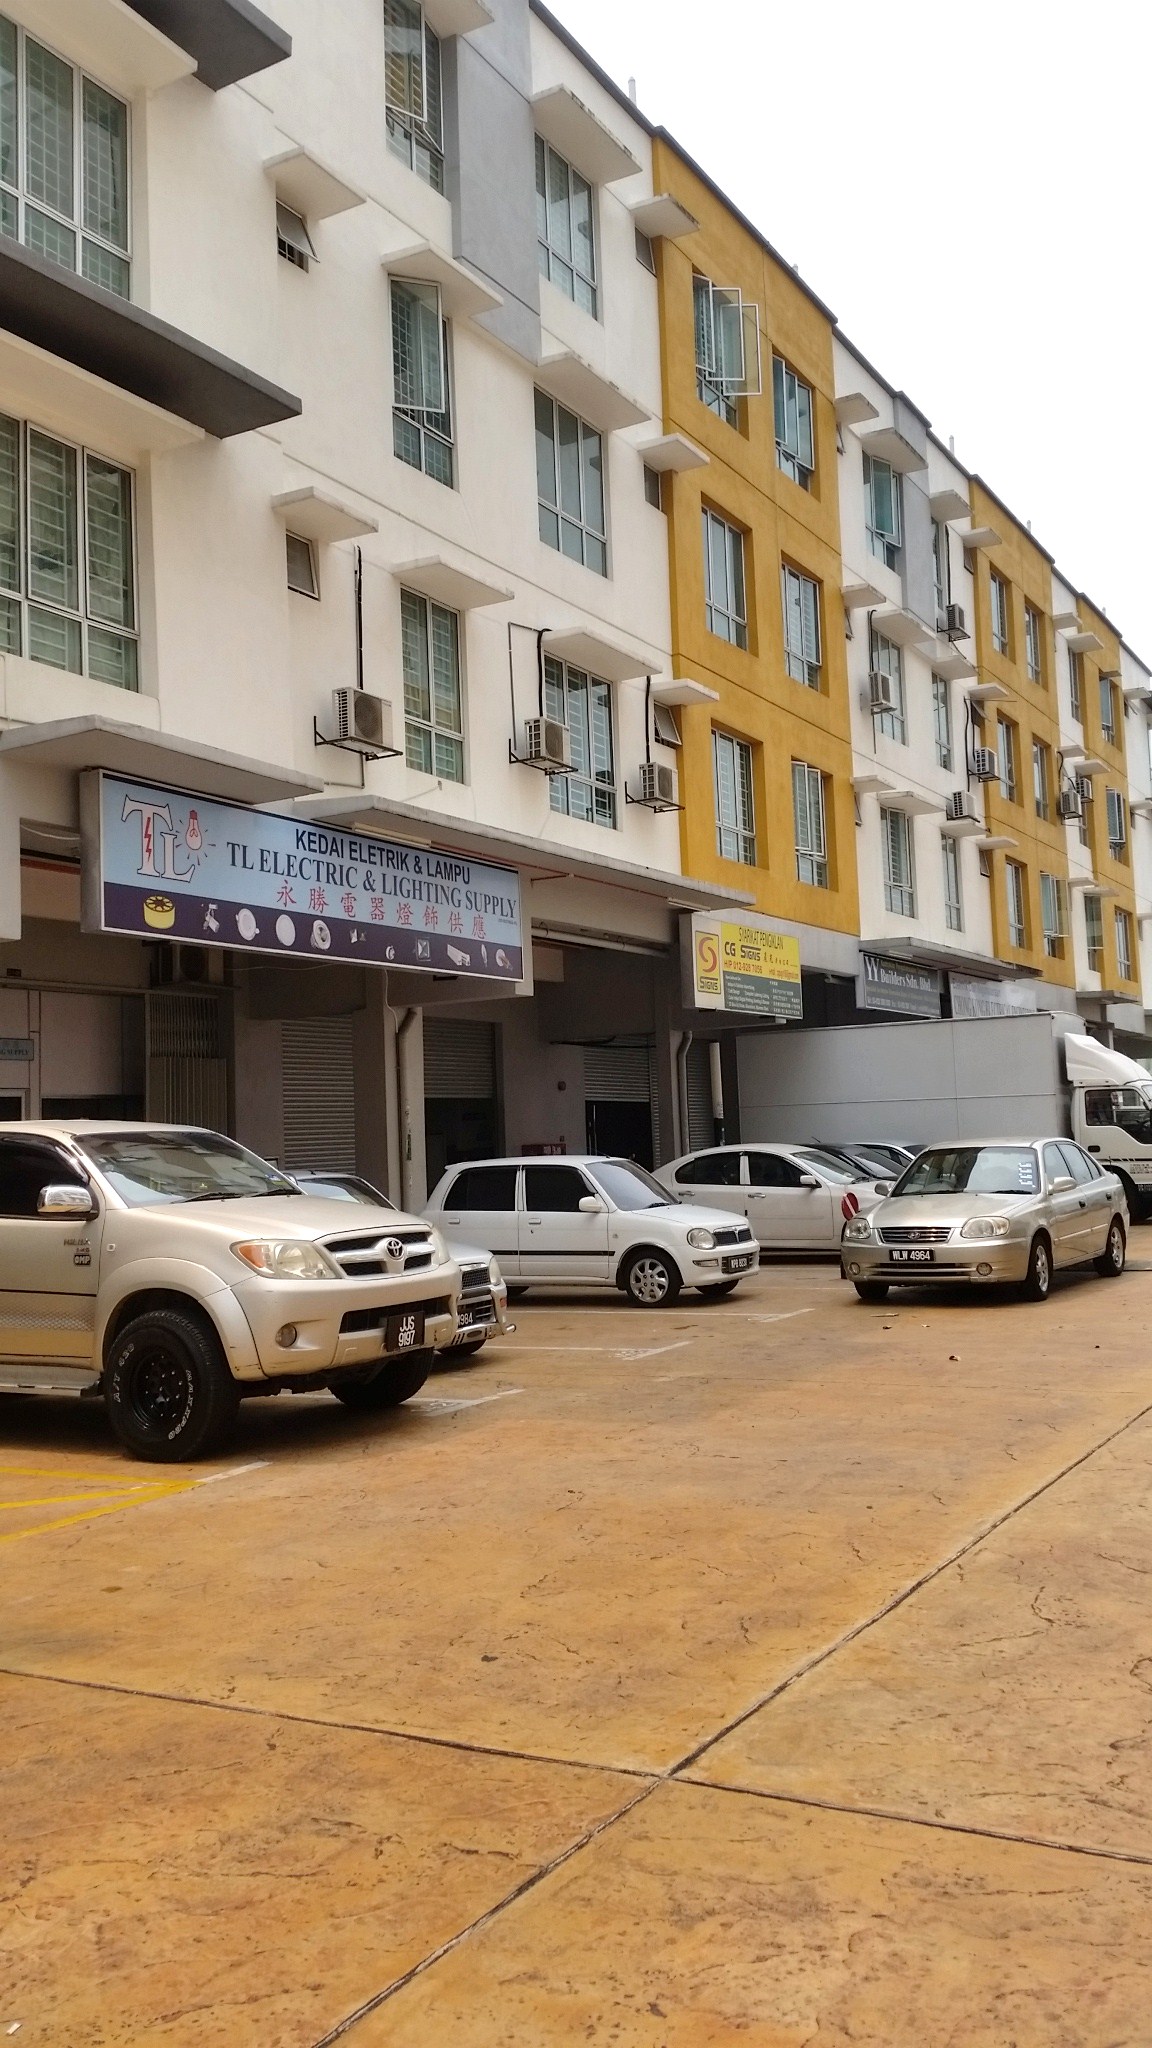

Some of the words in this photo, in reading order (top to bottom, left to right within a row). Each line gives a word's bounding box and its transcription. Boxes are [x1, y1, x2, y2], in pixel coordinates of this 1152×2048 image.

[296, 828, 344, 859] KEDAI
[349, 840, 410, 873] ELETRIK
[413, 855, 422, 875] &
[427, 858, 470, 885] LAMPU
[227, 842, 254, 870] TL
[259, 848, 357, 889] ELECTRIC
[363, 870, 376, 892] &
[382, 873, 461, 908] LIGHTING
[465, 890, 516, 919] SUPPLY
[276, 879, 487, 940] 永勝電器燈飾供應
[724, 941, 736, 957] CG
[880, 968, 905, 987] Builders
[905, 973, 919, 989] Sdn.
[892, 1251, 908, 1260] WLW
[910, 1251, 930, 1260] 4964
[400, 1315, 415, 1332] JJS
[398, 1330, 415, 1347] 9197
